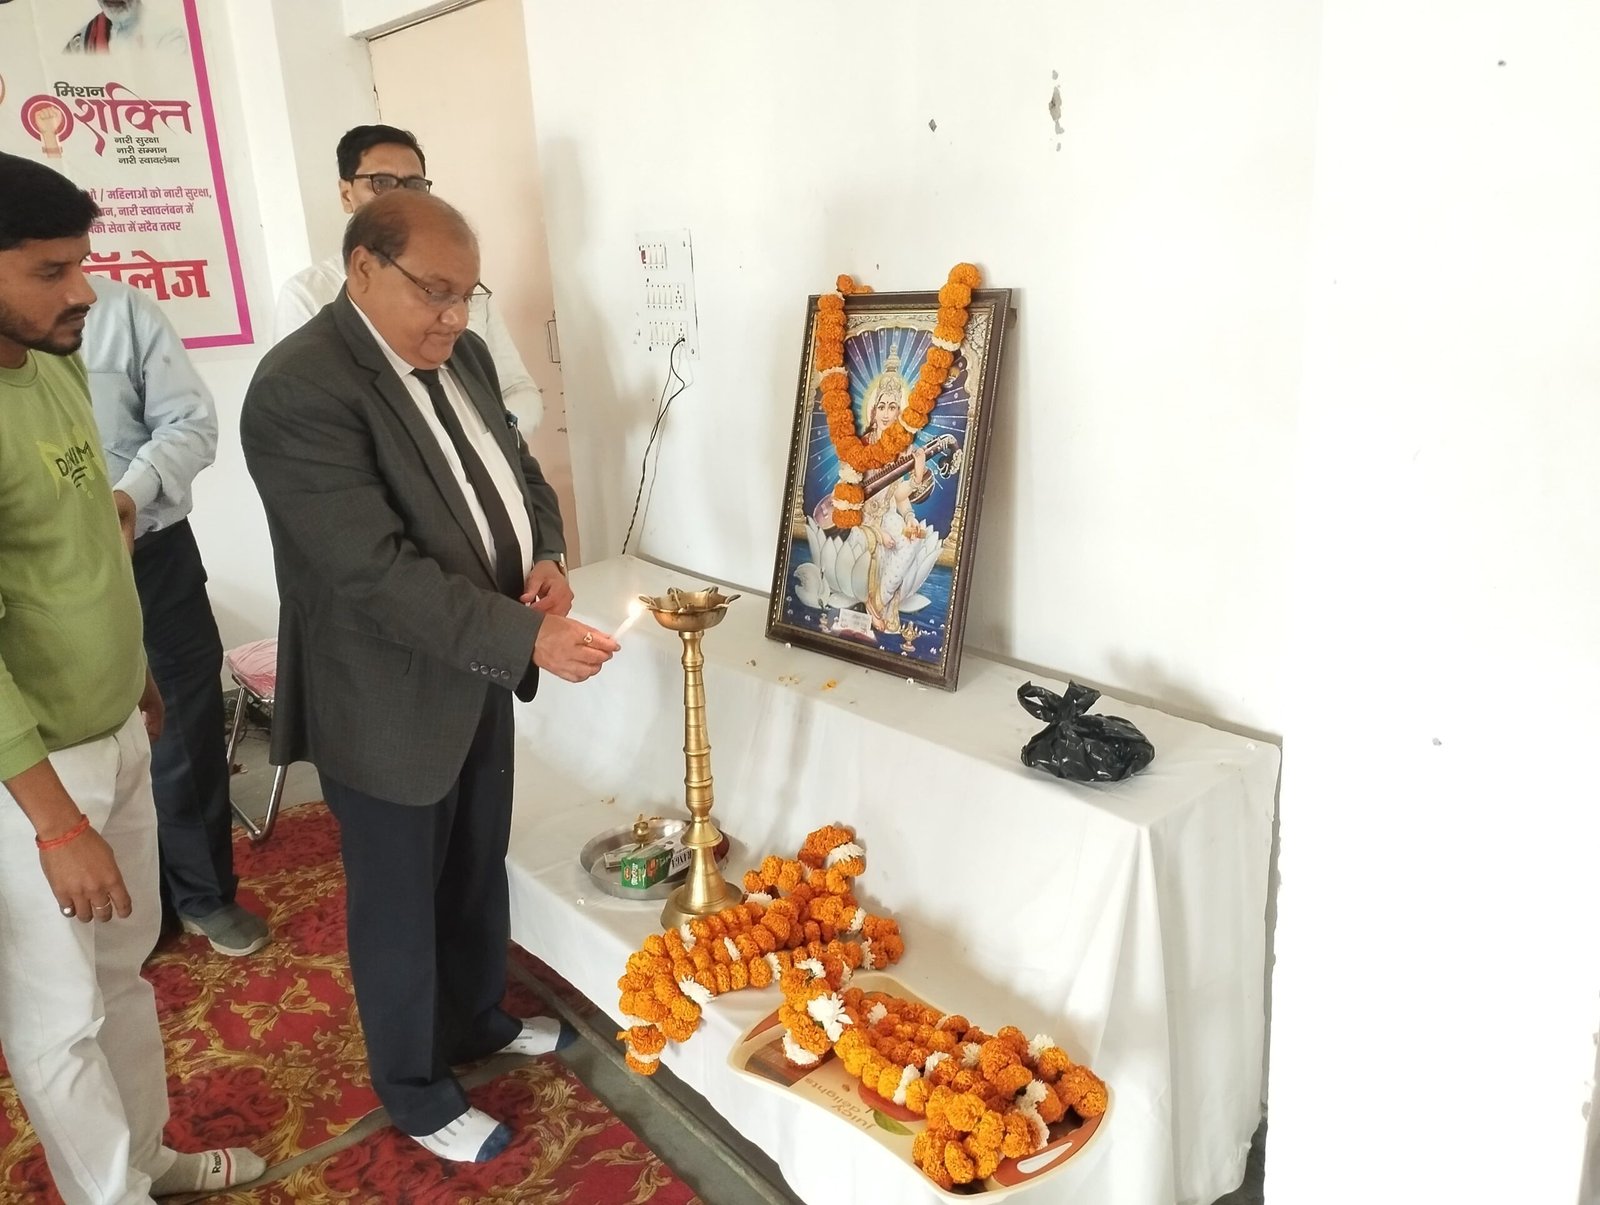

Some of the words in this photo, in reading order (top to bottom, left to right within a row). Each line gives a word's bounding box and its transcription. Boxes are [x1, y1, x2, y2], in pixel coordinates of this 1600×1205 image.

[54, 81, 105, 98] मिशन
[73, 82, 192, 157] शक्ति
[114, 134, 133, 144] नारी
[135, 136, 160, 146] सुरक्षा
[116, 145, 135, 154] नारी
[118, 155, 136, 164] नारी
[149, 186, 162, 199] को
[163, 186, 183, 199] नारी
[117, 204, 138, 216] नारी
[140, 203, 184, 216] स्वावलंबन
[185, 202, 195, 214] में
[107, 221, 126, 233] सेवा
[127, 220, 137, 232] में
[137, 220, 158, 232] सदैव
[159, 222, 181, 232] तत्पर
